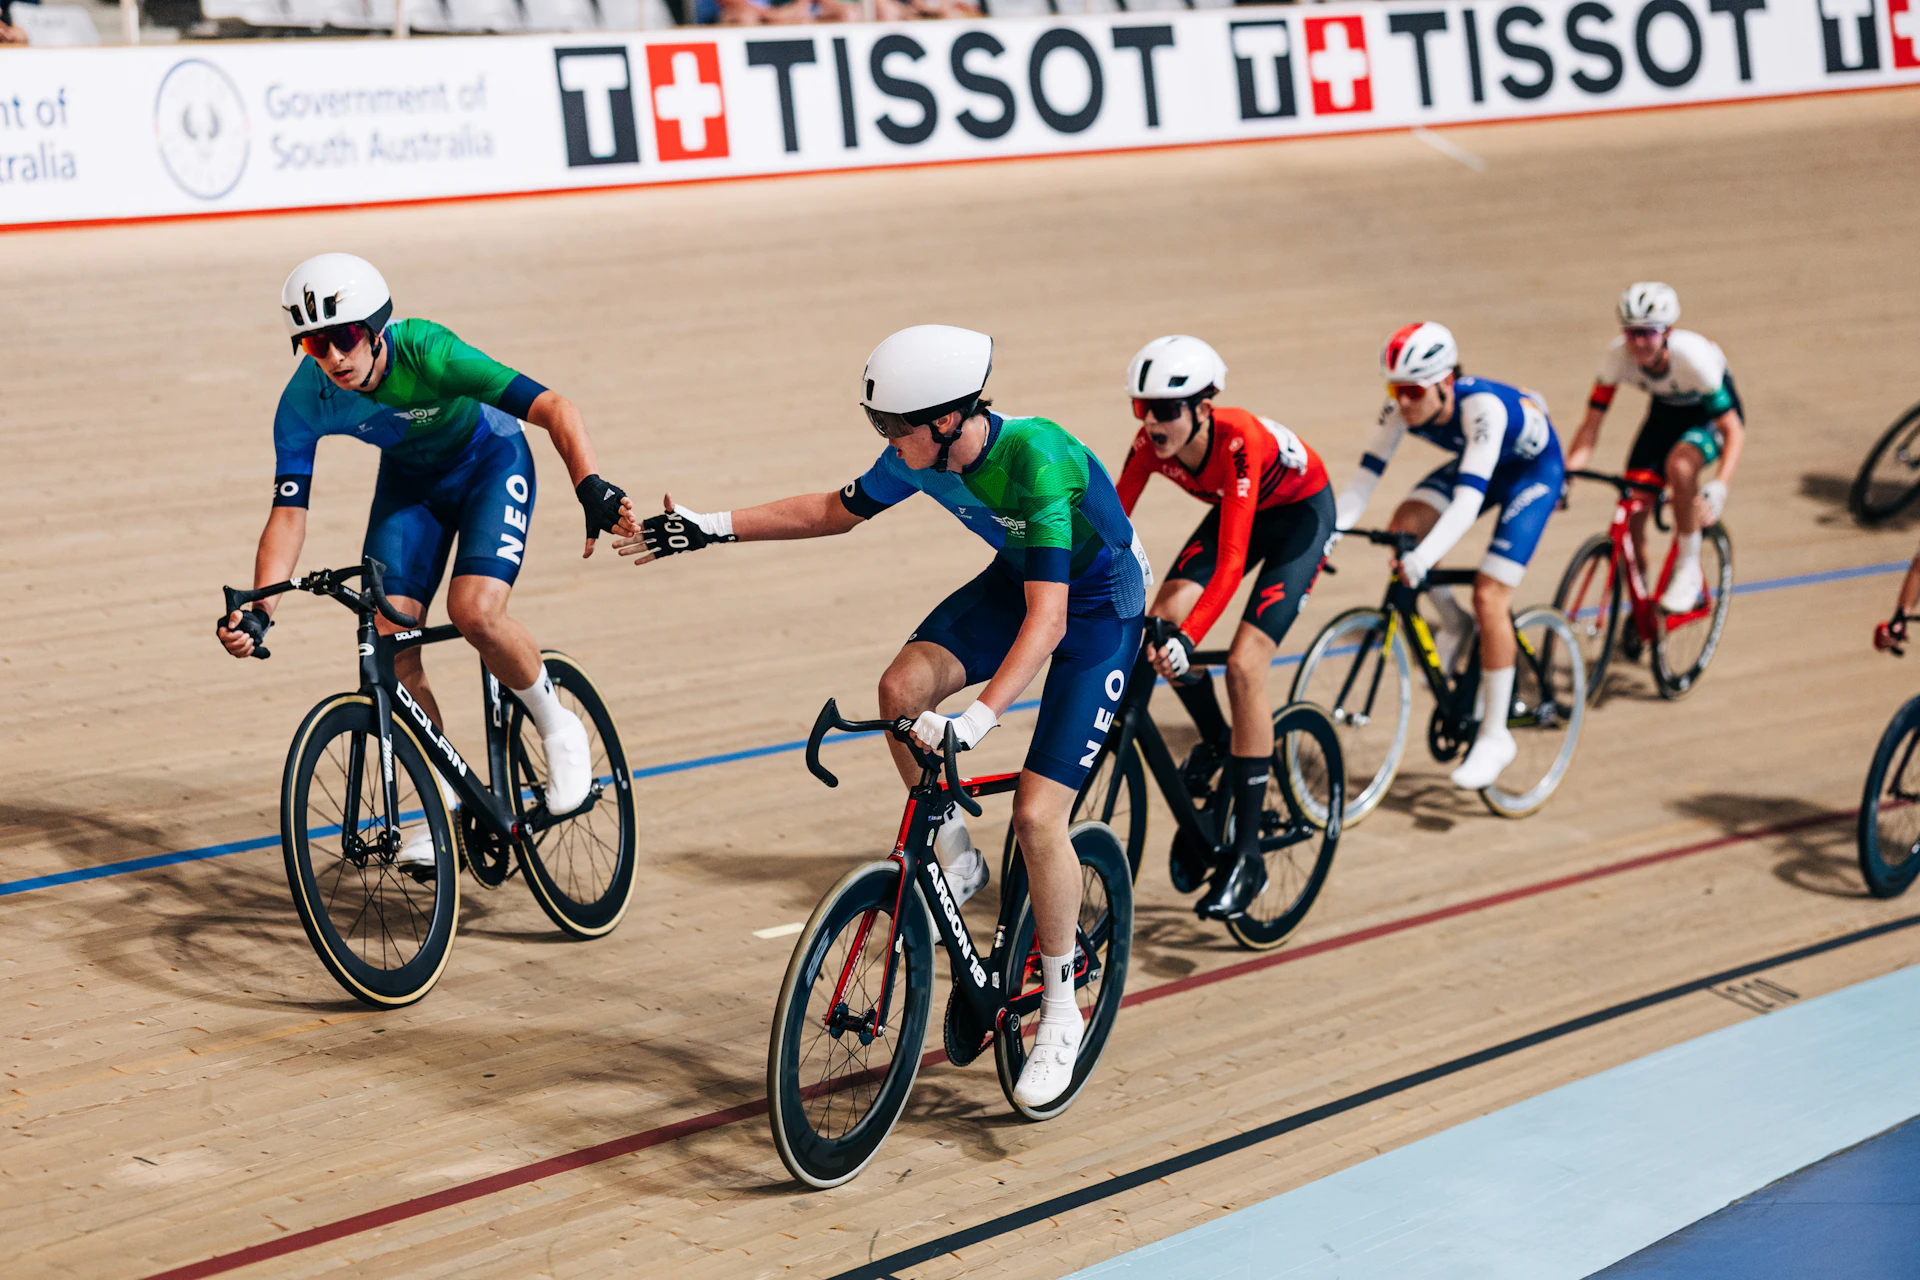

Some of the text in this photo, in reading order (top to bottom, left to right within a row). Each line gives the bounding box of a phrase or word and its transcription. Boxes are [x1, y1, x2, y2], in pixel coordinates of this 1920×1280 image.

[264, 72, 488, 121] Government of
[746, 25, 1175, 153] TISSOT
[1388, 0, 1766, 107] TISSOT
[36, 86, 68, 128] of
[270, 122, 496, 173] South Australia
[0, 140, 78, 183] ralia
[496, 474, 529, 566] NEO
[395, 681, 468, 778] DOLAN
[1079, 669, 1125, 769] NEO
